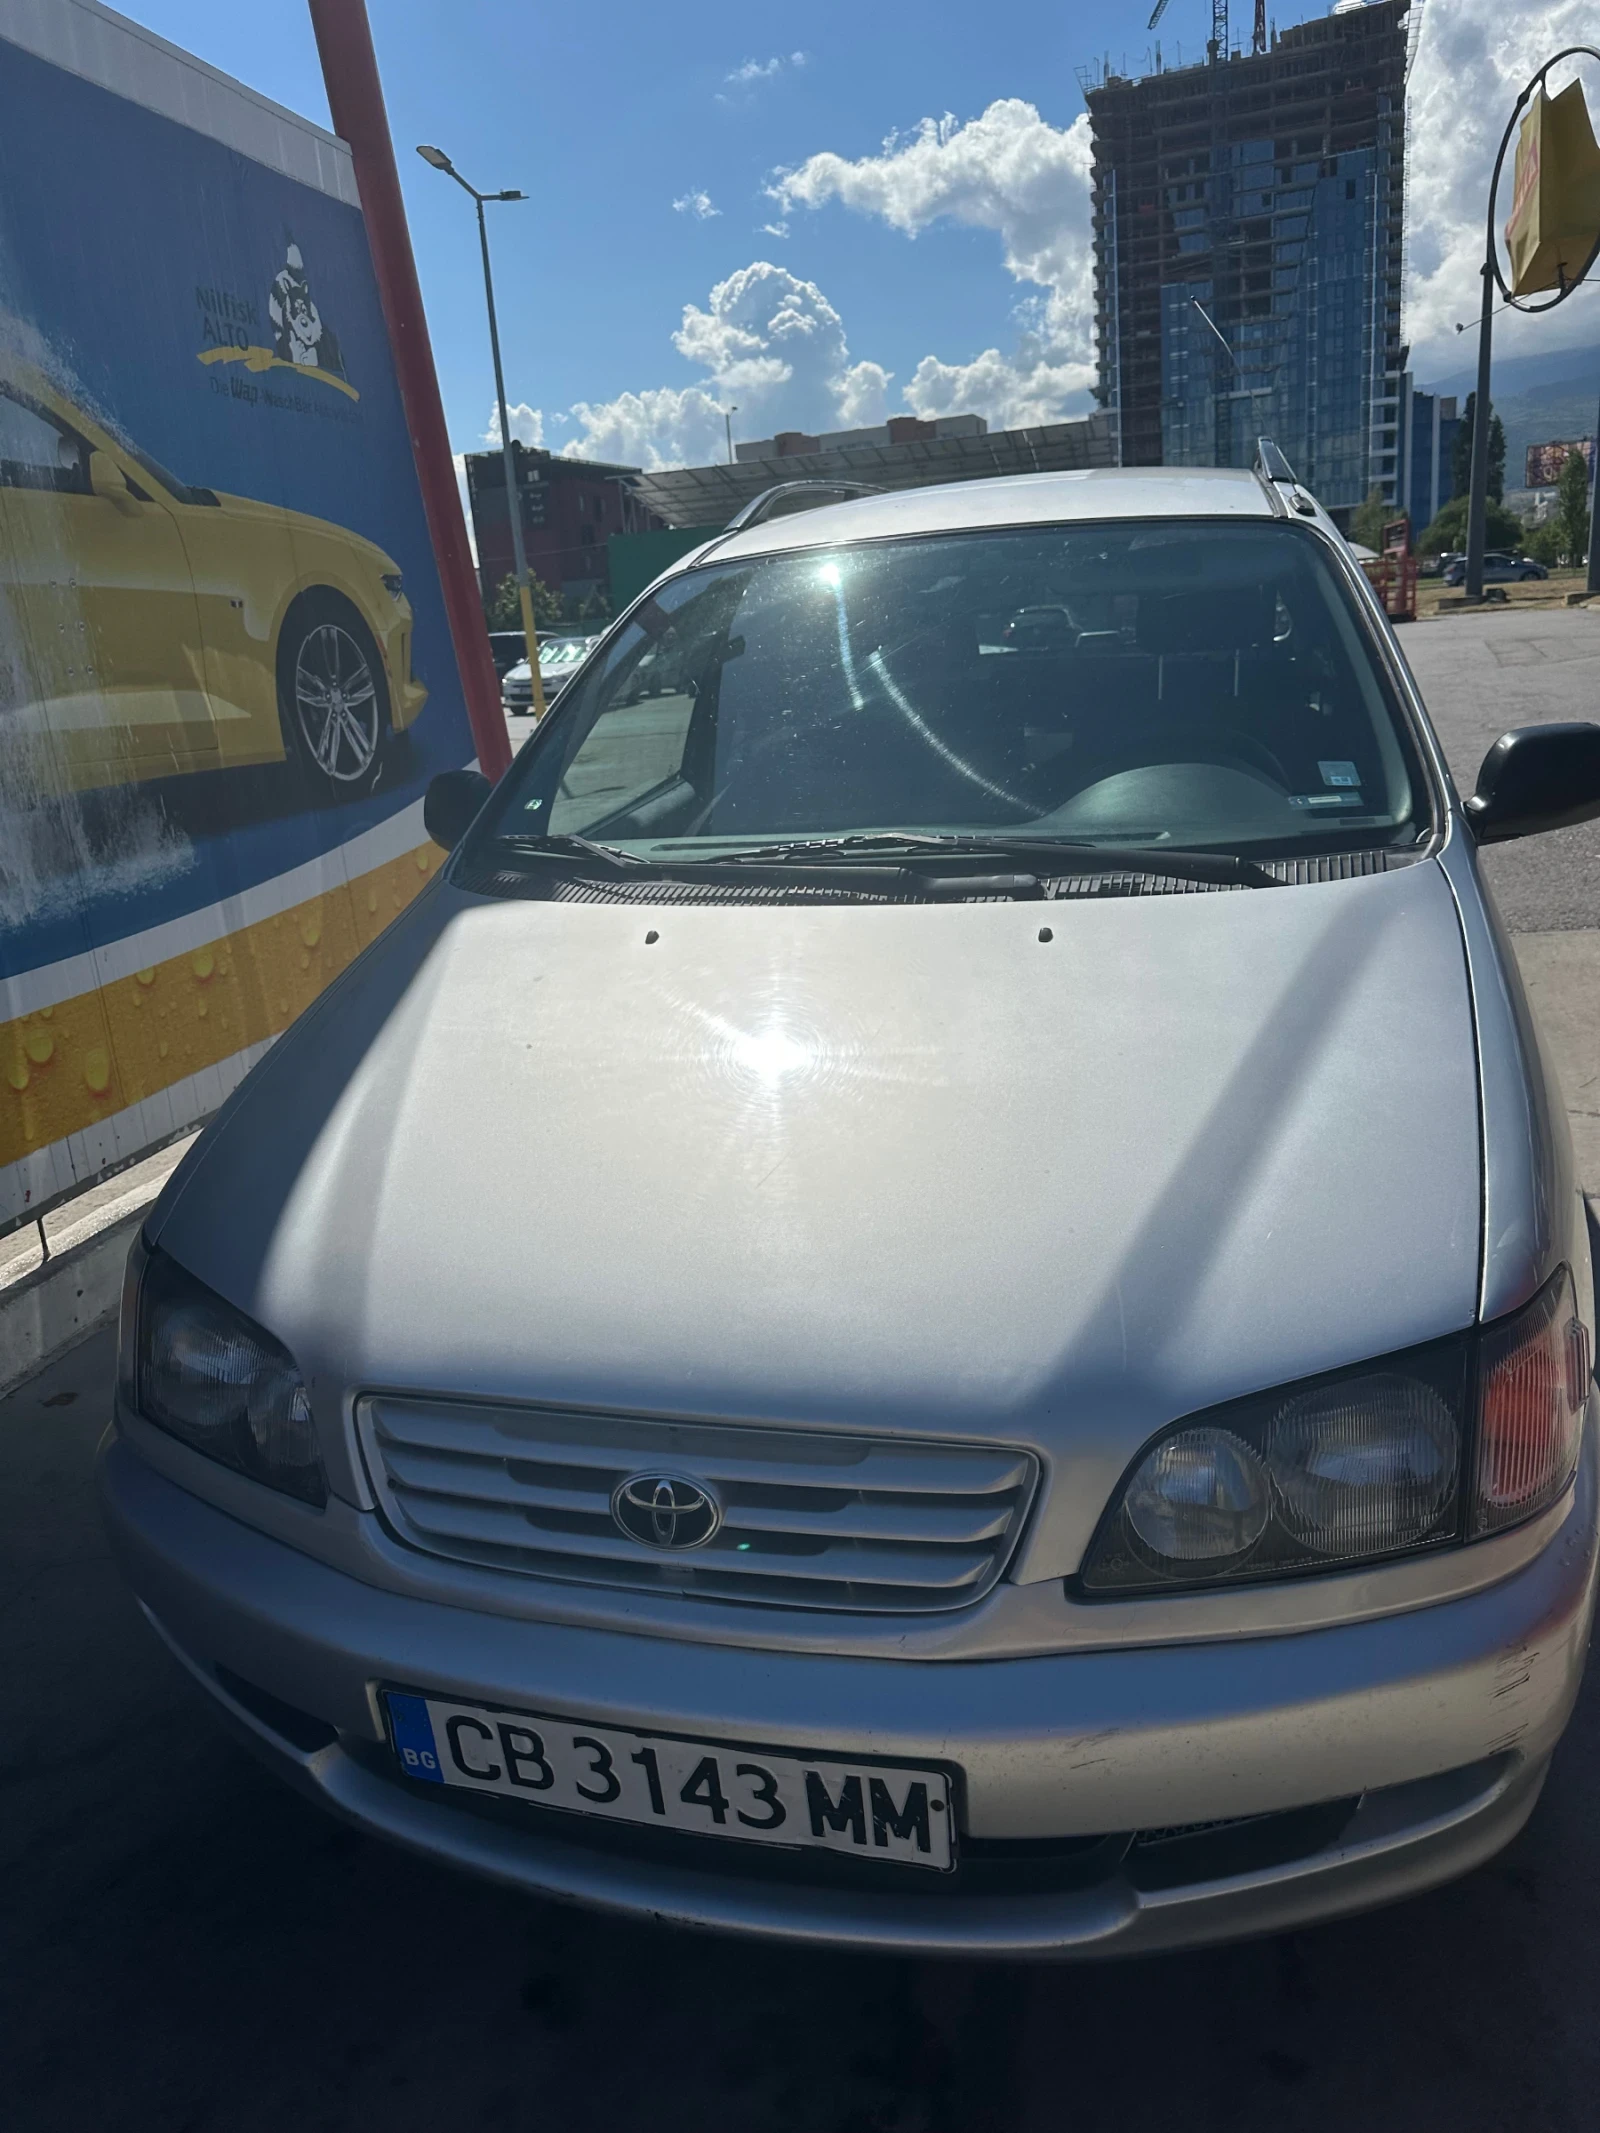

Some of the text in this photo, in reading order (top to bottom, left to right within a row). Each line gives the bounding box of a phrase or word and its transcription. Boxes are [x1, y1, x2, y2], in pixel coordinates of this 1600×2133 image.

[196, 285, 258, 325] Nilfisk
[202, 316, 250, 351] ALTO
[402, 1747, 436, 1769] BG
[446, 1714, 931, 1854] CB 3143 MM
